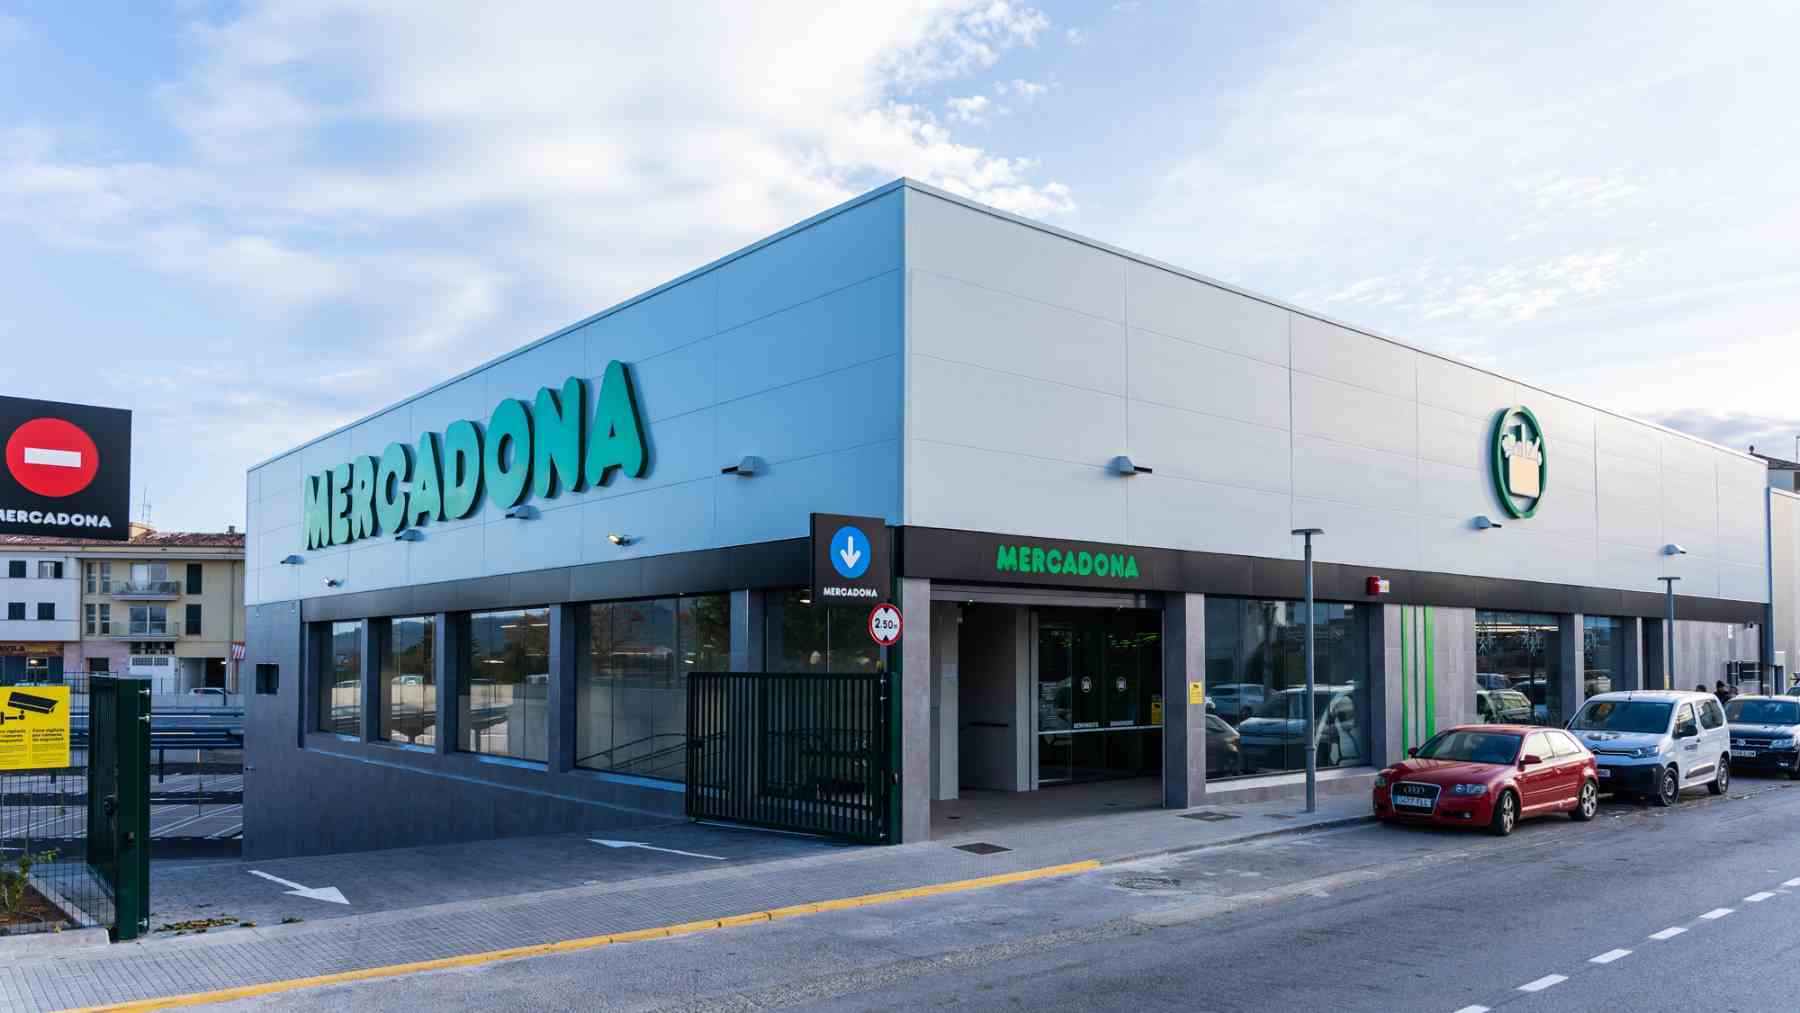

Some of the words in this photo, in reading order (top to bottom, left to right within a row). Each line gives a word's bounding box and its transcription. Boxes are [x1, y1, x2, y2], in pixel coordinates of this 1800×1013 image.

[303, 360, 650, 550] MERCADONA
[996, 543, 1140, 577] MERCADONA
[823, 587, 878, 597] MERCADONA
